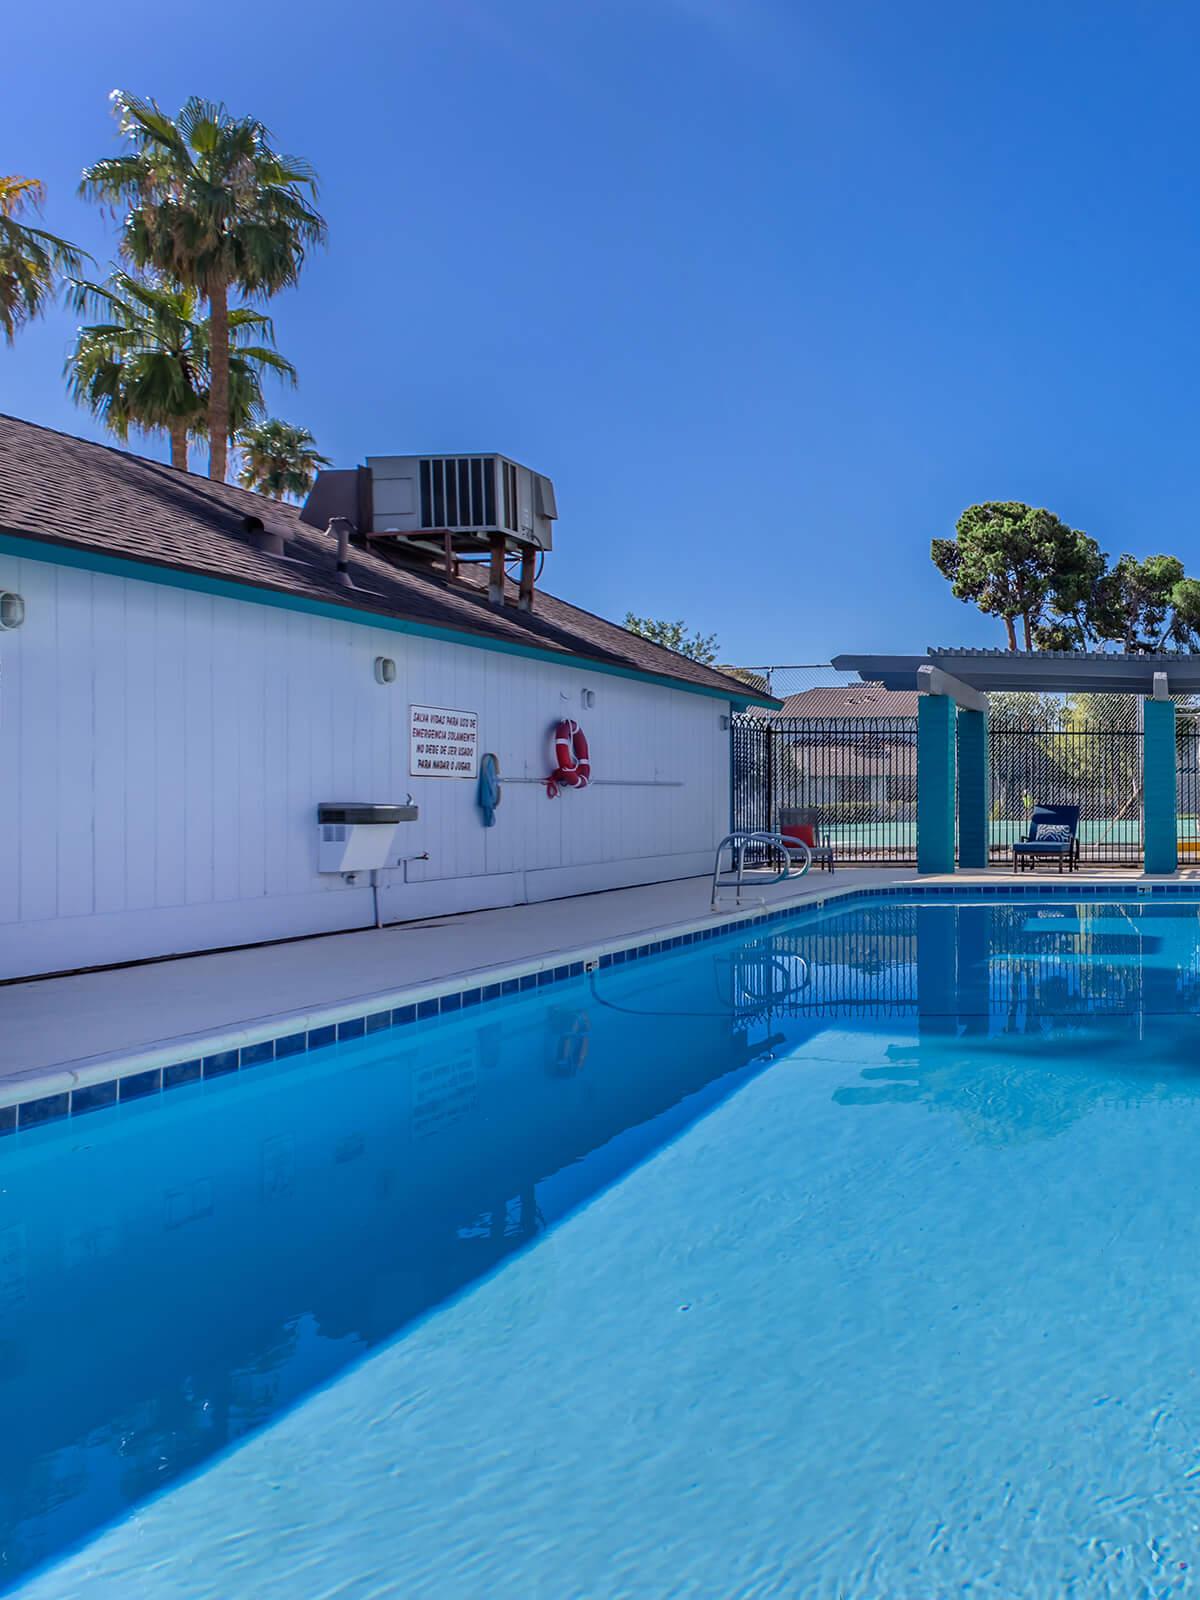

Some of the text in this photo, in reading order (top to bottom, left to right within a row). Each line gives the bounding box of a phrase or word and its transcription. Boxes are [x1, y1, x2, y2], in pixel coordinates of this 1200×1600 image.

[446, 716, 458, 726] PARA
[412, 728, 476, 743] EMERGENCIA SOLAMENTE
[416, 744, 424, 753] NO
[425, 744, 439, 755] DEBE
[440, 745, 447, 755] DE
[417, 759, 431, 769] PARA
